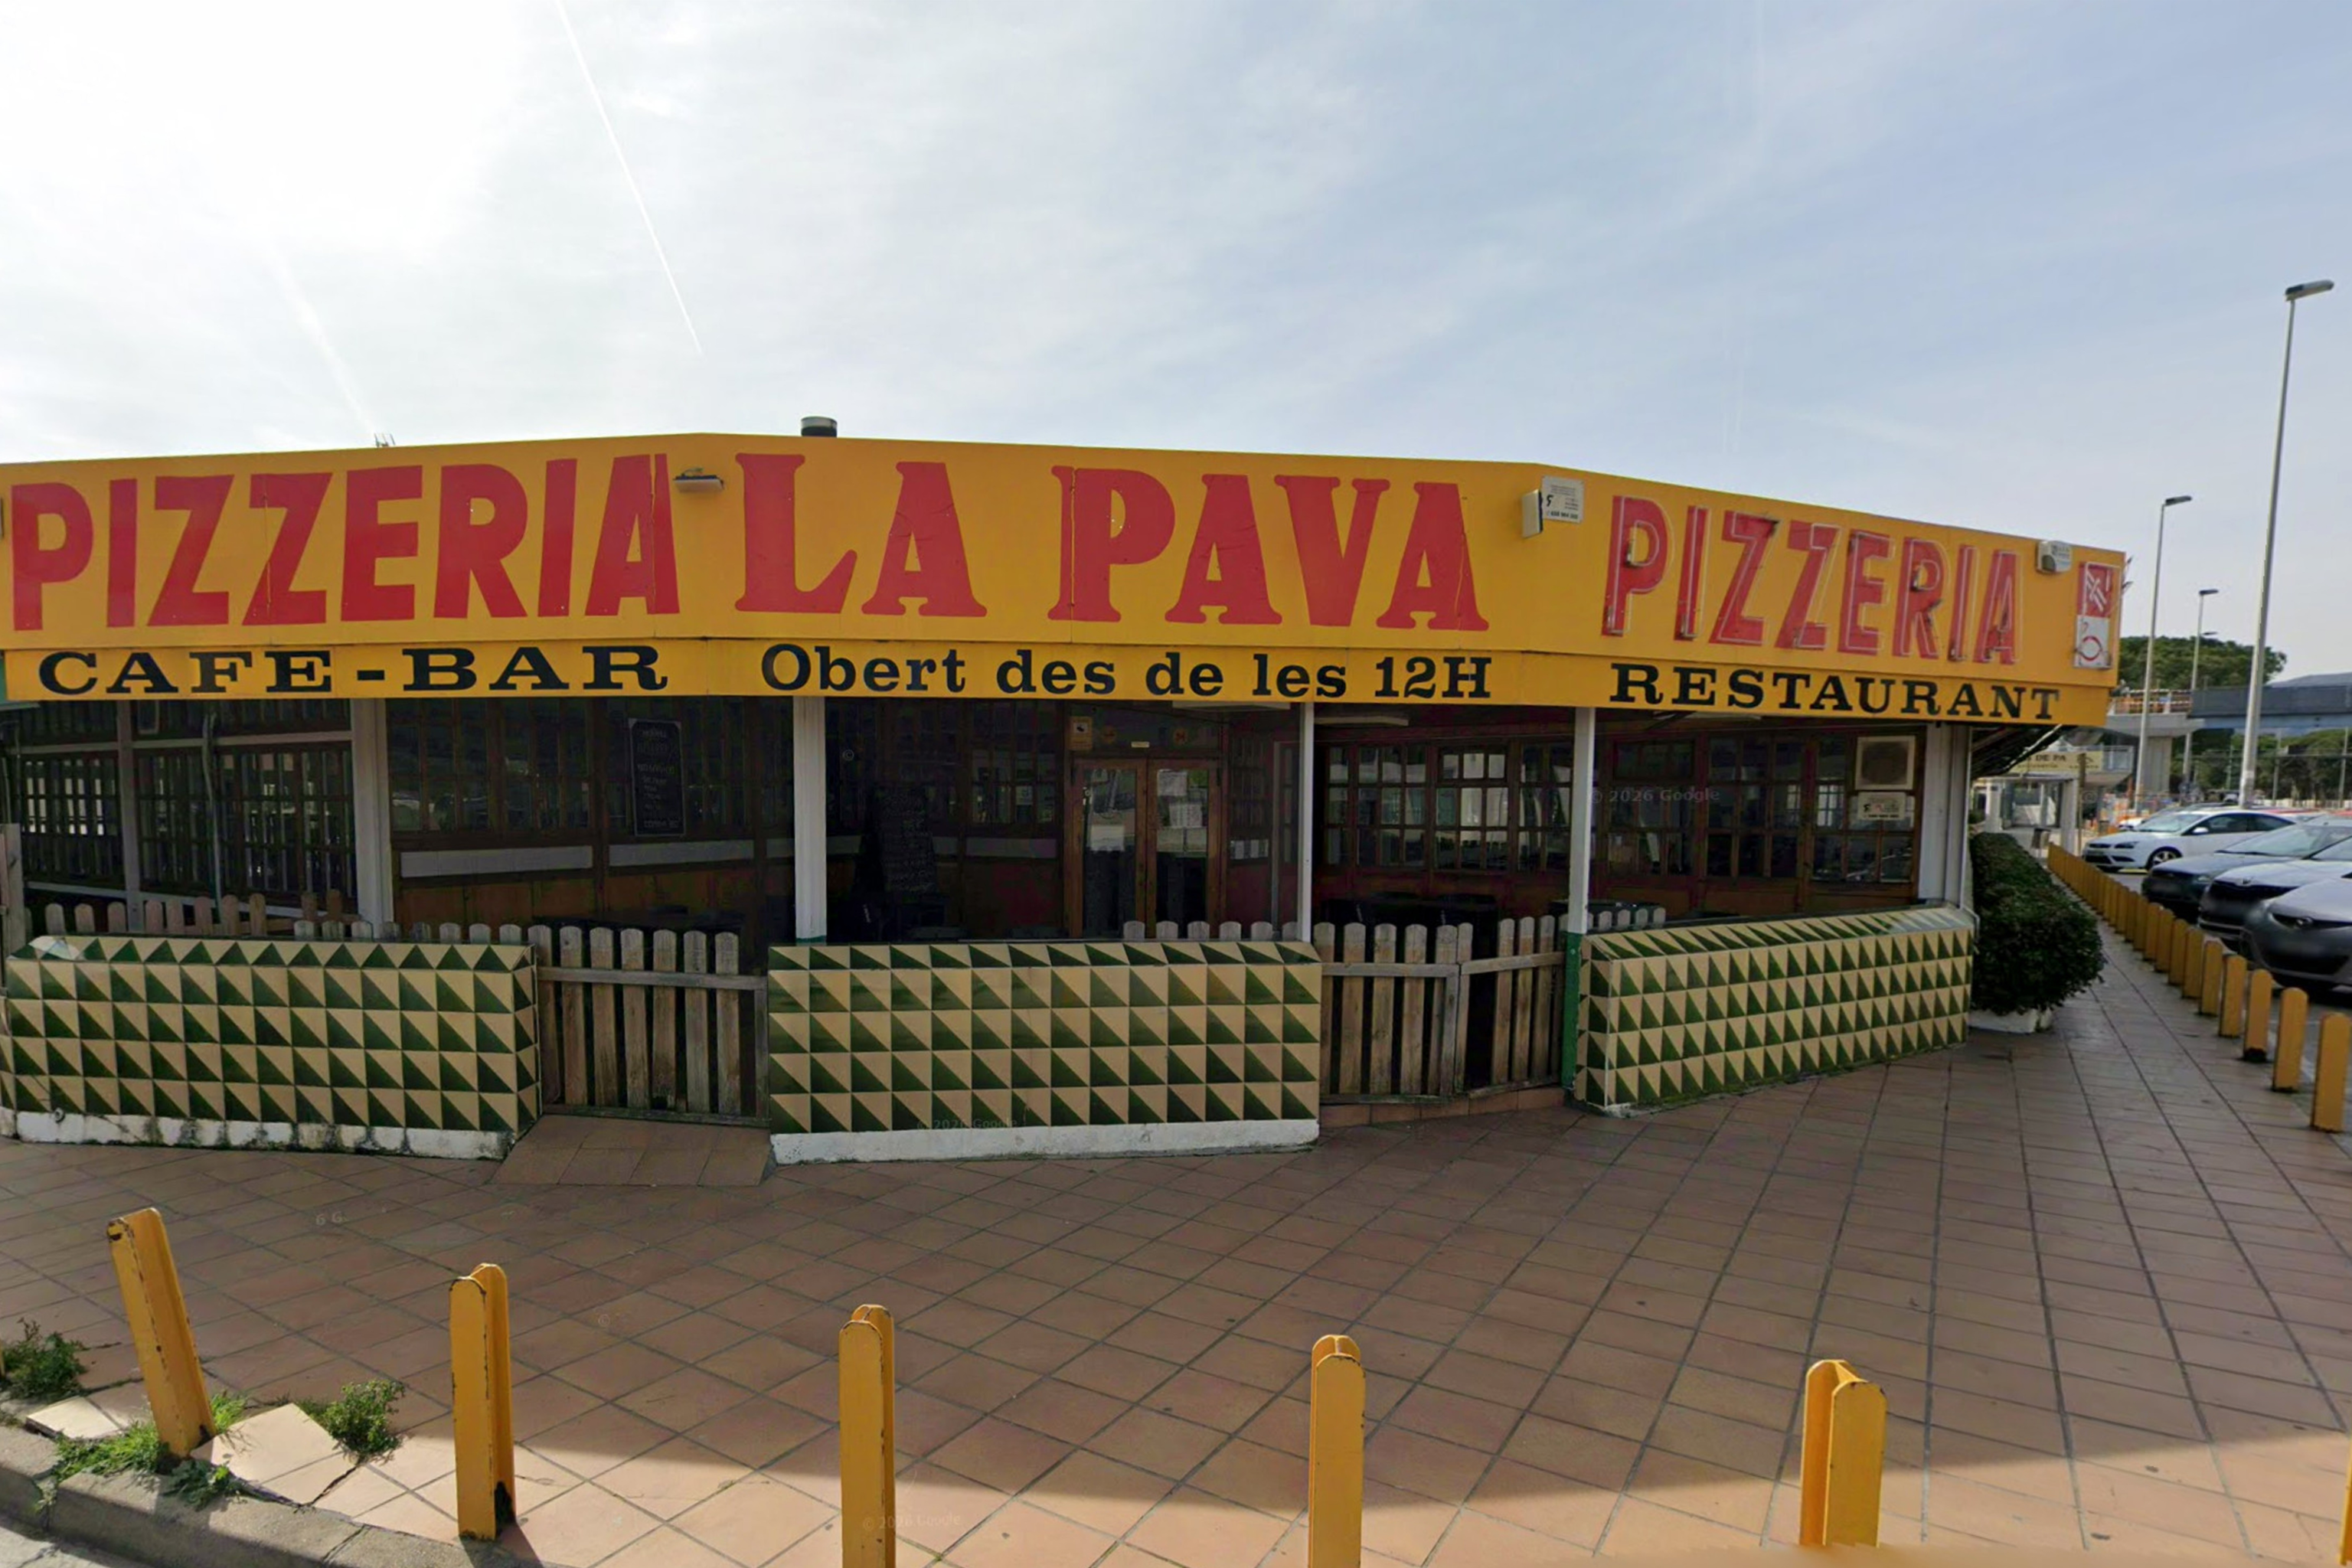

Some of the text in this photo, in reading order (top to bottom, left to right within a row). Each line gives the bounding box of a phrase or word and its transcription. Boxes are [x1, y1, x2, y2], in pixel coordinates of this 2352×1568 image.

[11, 453, 680, 631] PIZZERIA
[735, 453, 1490, 632] LA PAVA
[1601, 495, 2021, 666] PIZZERIA
[761, 643, 1492, 699] Obert des de les 12H
[1609, 662, 2060, 720] RESTAURANT
